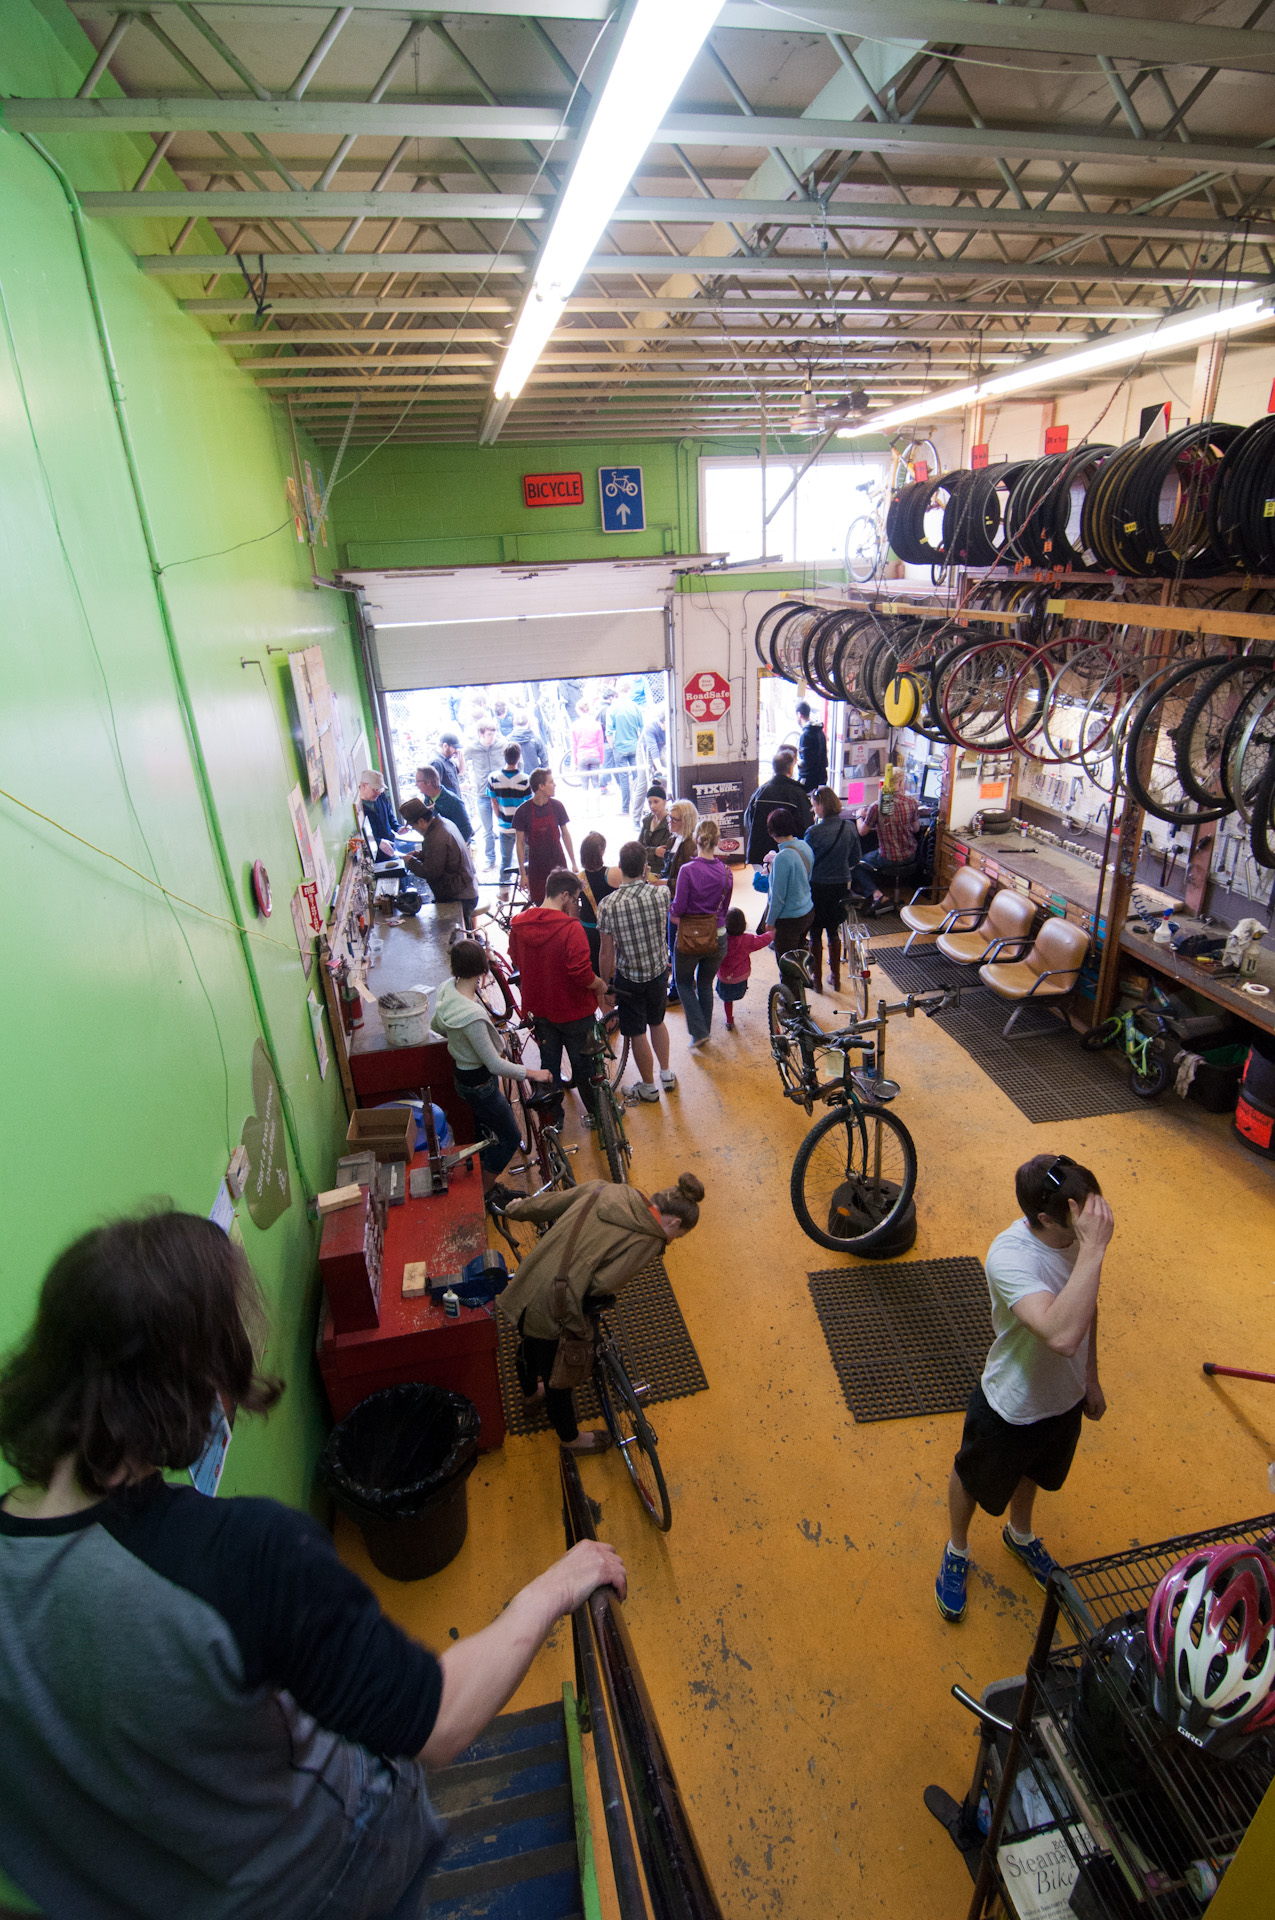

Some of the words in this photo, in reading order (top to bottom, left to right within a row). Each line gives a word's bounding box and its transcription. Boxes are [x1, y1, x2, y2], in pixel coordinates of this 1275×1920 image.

[528, 481, 580, 498] BICYCLE
[686, 690, 730, 701] RoadSafe
[692, 784, 720, 796] FIX
[1177, 1726, 1203, 1747] GIRO
[1036, 1863, 1074, 1895] Bike
